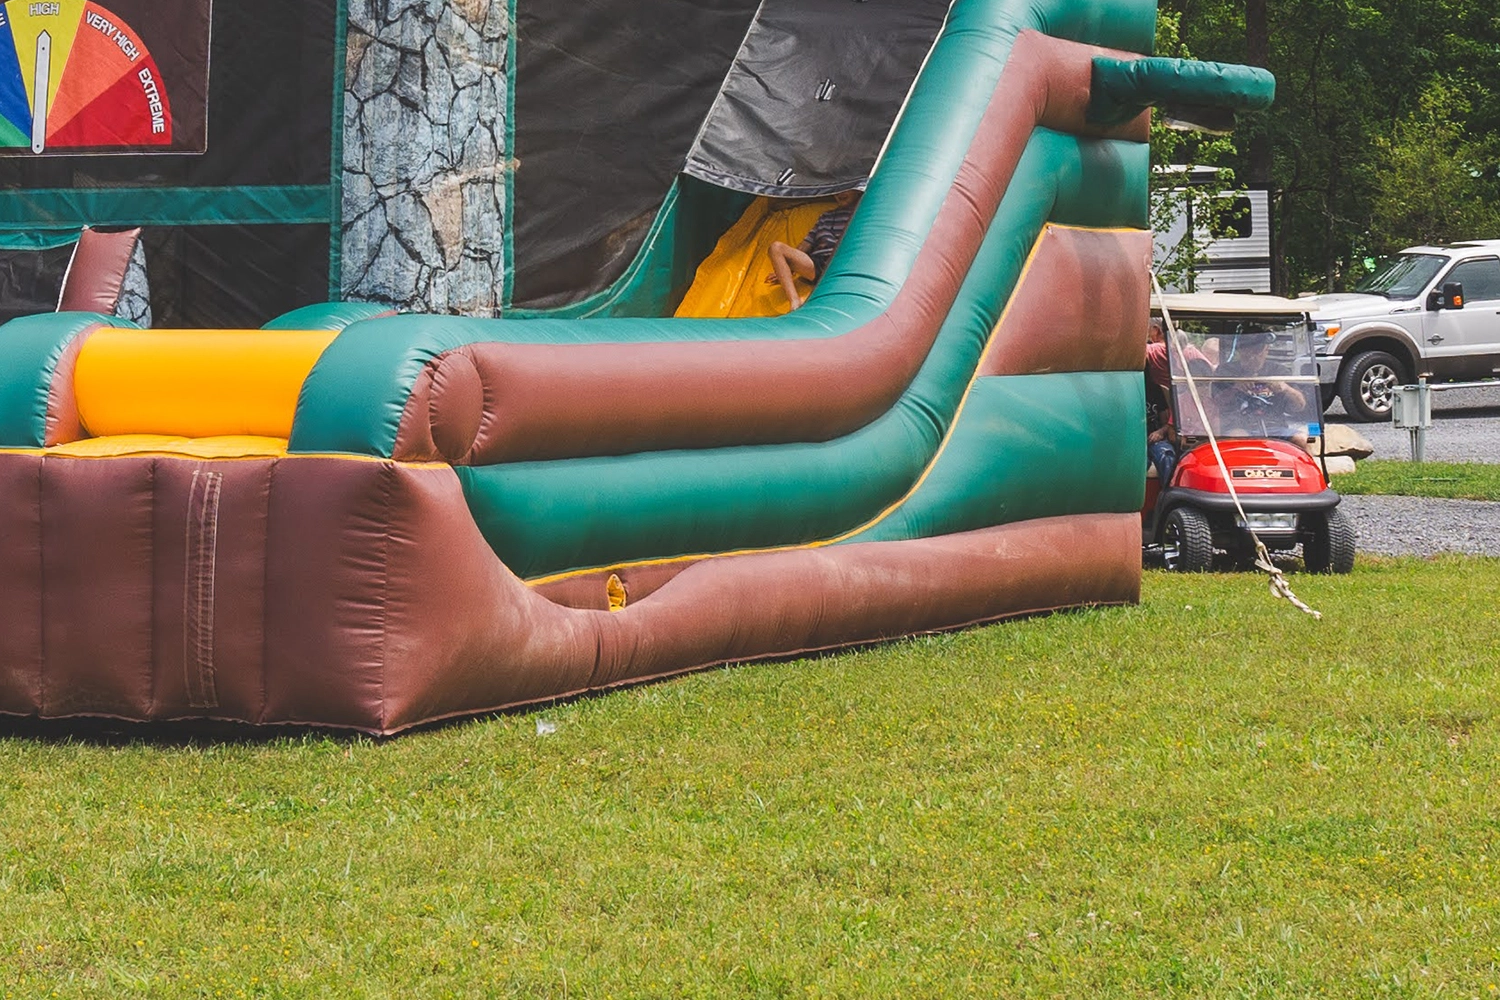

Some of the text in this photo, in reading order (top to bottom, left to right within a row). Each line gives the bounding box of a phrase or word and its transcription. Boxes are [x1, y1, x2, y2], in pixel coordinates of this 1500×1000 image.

[29, 2, 60, 16] HIGH
[85, 10, 141, 62] VERY HIGH
[137, 67, 165, 134] EXTREME
[1244, 469, 1282, 478] Club Car
